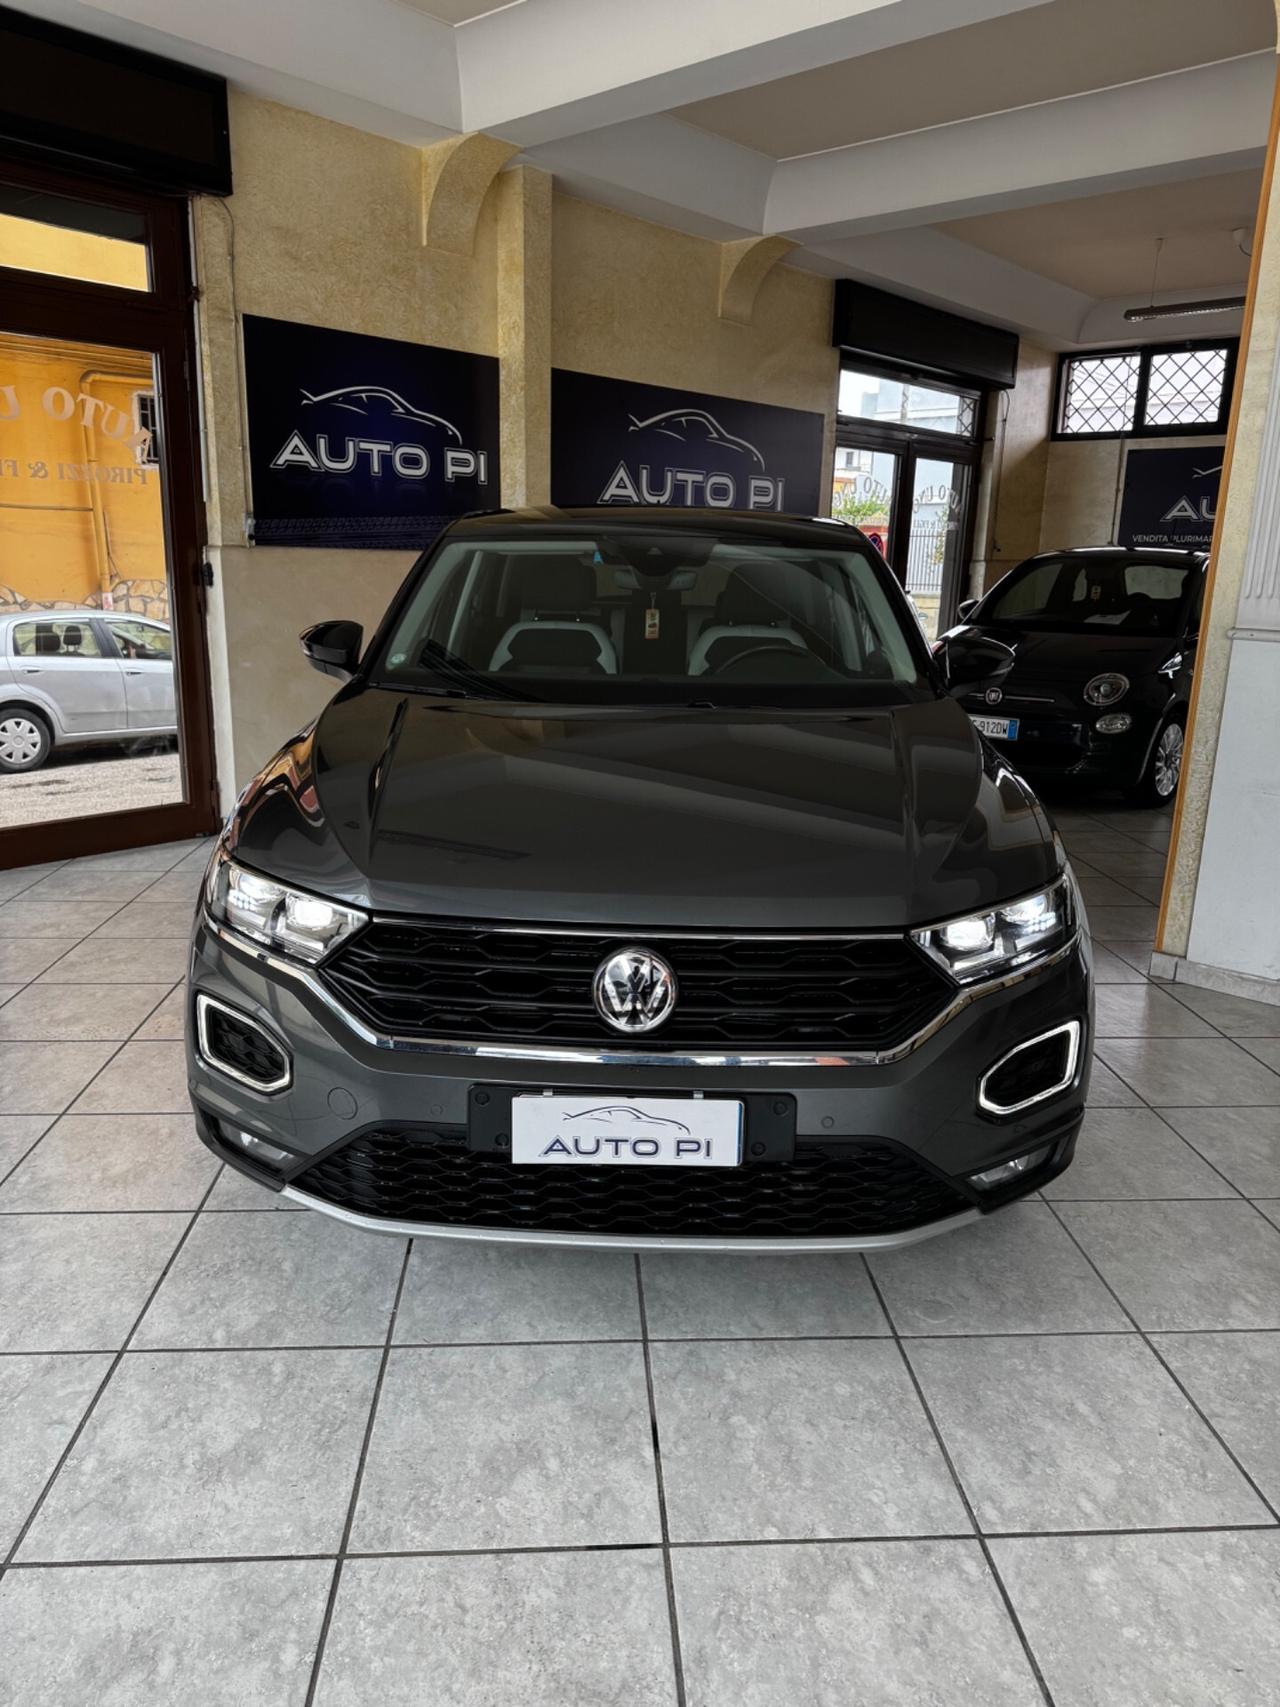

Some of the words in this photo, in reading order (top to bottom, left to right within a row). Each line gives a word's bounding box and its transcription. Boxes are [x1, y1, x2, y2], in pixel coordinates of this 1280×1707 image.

[269, 430, 431, 479] AUTO
[444, 447, 488, 485] PI
[597, 460, 736, 507] AUTO
[749, 475, 785, 511] PI
[1132, 535, 1169, 543] VENDITA
[539, 1135, 662, 1158] AUTO
[675, 1138, 712, 1159] PI
